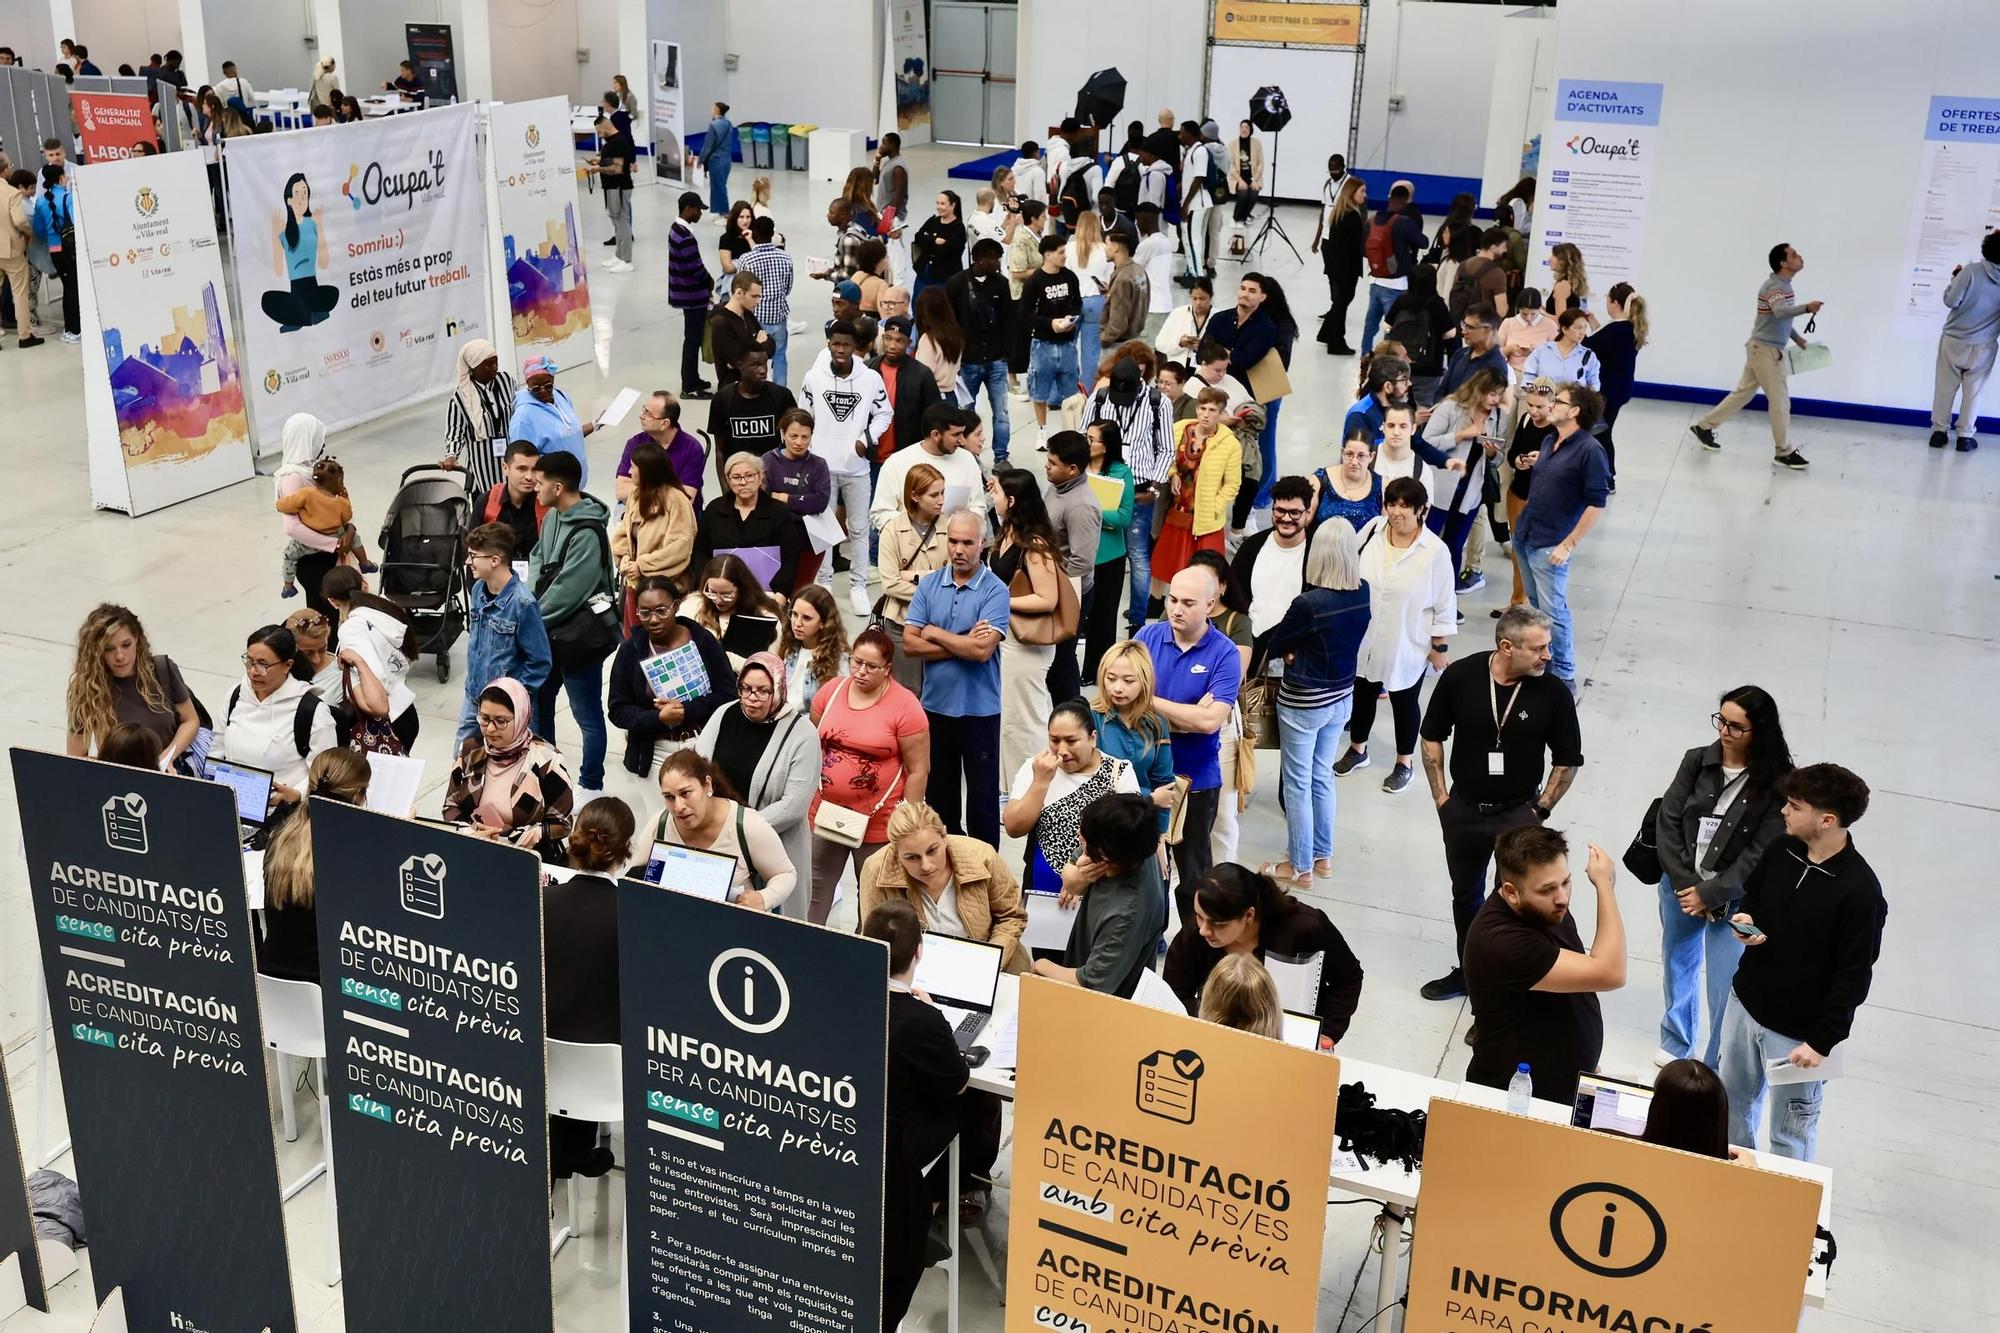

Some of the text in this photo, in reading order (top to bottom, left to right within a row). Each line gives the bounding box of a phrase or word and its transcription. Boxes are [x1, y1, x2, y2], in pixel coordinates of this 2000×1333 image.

[94, 107, 141, 118] GENERALITAT
[96, 116, 142, 126] VALENCIANA
[1567, 102, 1644, 116] D'ACTIVITATS
[1568, 90, 1618, 101] AGENDA
[1942, 109, 2000, 121] OFERTES
[88, 144, 133, 160] LABO
[1581, 137, 1640, 161] Ocupa't
[1940, 122, 1958, 132] DE
[363, 150, 444, 210] Ocupa't
[132, 218, 170, 232] Ajuntament
[348, 228, 405, 258] Somriu :)
[349, 250, 452, 286] Estàs més a prop
[351, 265, 470, 308] del teu futur treball.
[1044, 282, 1068, 294] GAME
[1046, 290, 1069, 300] OVER
[735, 419, 770, 434] ICON
[50, 861, 224, 915] ACREDITACIÓ
[53, 886, 228, 938] DE CANDIDATS/ES
[59, 915, 234, 963] sense cita prèvia
[339, 920, 518, 990] ACREDITACIÓ
[65, 969, 238, 1024] ACREDITACIÓN
[341, 947, 520, 1016] DE CANDIDATS/ES
[69, 996, 241, 1048] DE CANDIDATOS/AS
[345, 977, 524, 1044] sense cita prèvia
[75, 1021, 248, 1076] sin cita previa
[346, 1036, 522, 1108] ACREDITACIÓN
[647, 1025, 857, 1109] INFORMACIÓ
[348, 1064, 524, 1135] DE CANDIDATOS/AS
[647, 1059, 857, 1135] PER A CANDIDATS/ES
[352, 1092, 529, 1165] sin cita previa
[651, 1090, 860, 1166] sense cita prèvia
[648, 1147, 856, 1219] 1. Si no et vas inscriure a temps en la web
[1044, 1118, 1291, 1212] ACREDITACIÓ
[649, 1161, 661, 1172] de
[665, 1166, 740, 1198] l'esdeveniment,
[744, 1192, 766, 1206] pots
[821, 1216, 836, 1228] ací
[840, 1222, 855, 1234] les
[649, 1175, 855, 1249] teues entrevistes. Serà imprescindible
[650, 1204, 680, 1220] paper.
[1043, 1147, 1289, 1242] DE CANDIDATS/ES
[650, 1191, 855, 1263] que portes el teu currículum imprés en
[1043, 1184, 1290, 1276] amb cita prèvia
[650, 1230, 854, 1306] 2. Per a poder-te assignar una entrevista
[651, 1245, 854, 1320] necessitaràs complir amb els requisits de
[651, 1257, 665, 1270] les
[669, 1264, 703, 1282] ofertes
[707, 1277, 713, 1286] a
[717, 1279, 731, 1292] les
[736, 1288, 754, 1300] que
[758, 1296, 769, 1305] et
[773, 1300, 793, 1313] vols
[797, 1308, 846, 1331] presentar
[1037, 1248, 1279, 1333] ACREDITACIÓN
[651, 1272, 669, 1285] que
[685, 1281, 731, 1305] l'empresa
[748, 1304, 772, 1320] tinga
[652, 1286, 697, 1308] d'agenda.
[652, 1311, 662, 1322] 3.
[674, 1318, 693, 1333] Una
[1035, 1273, 1209, 1333] DE CANDIDAT
[1036, 1305, 1087, 1333] con
[1446, 1301, 1513, 1333] PARA
